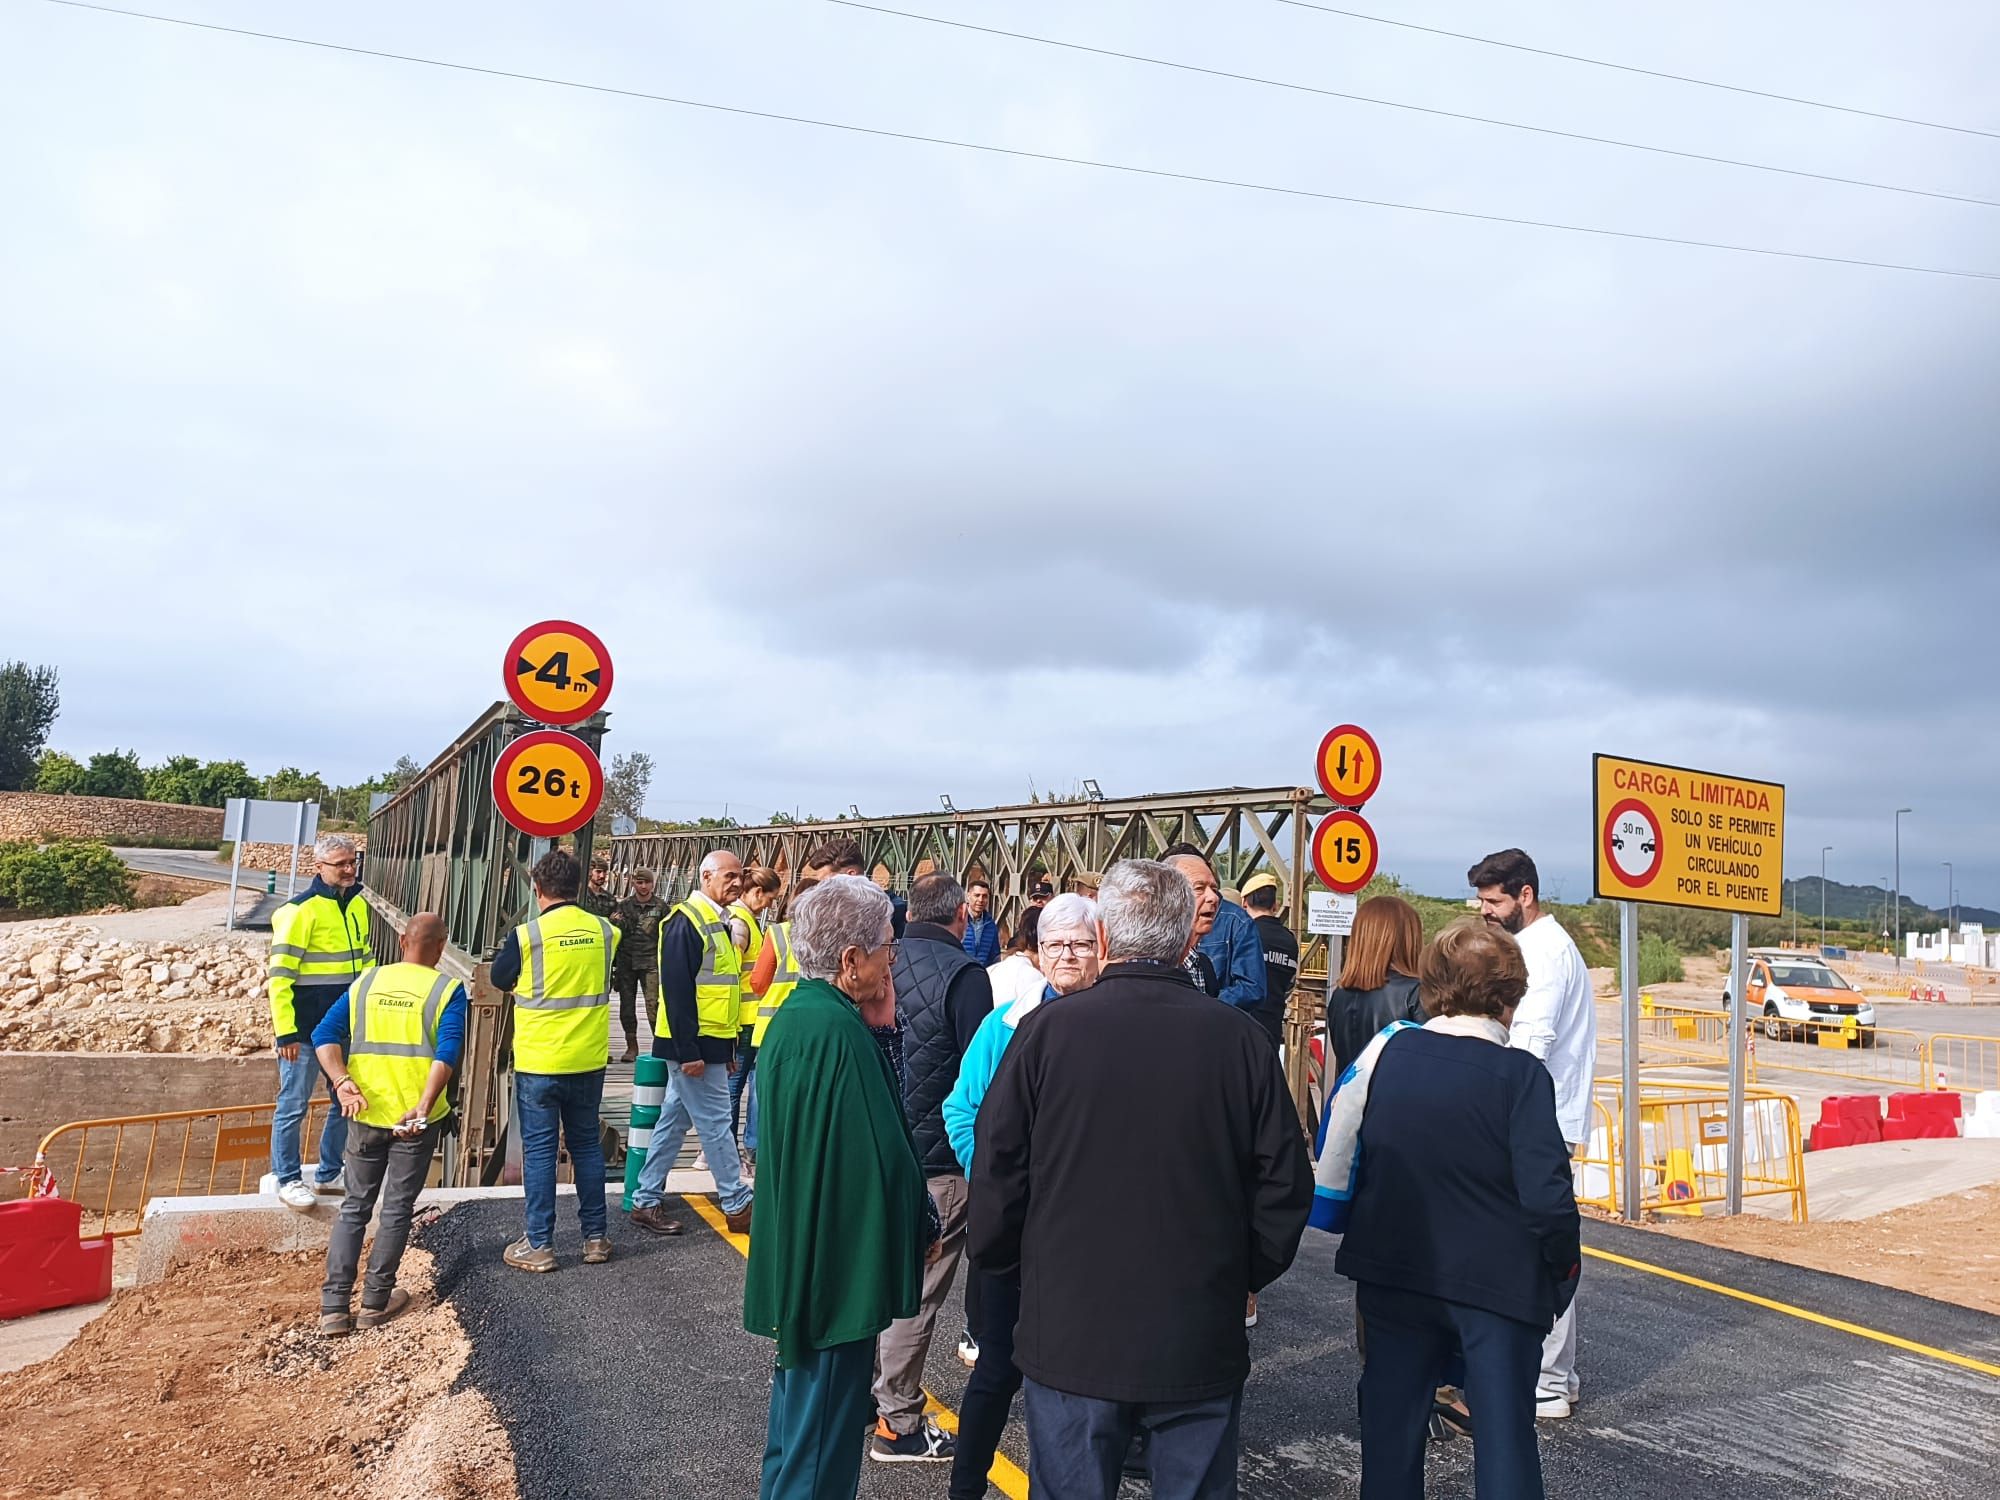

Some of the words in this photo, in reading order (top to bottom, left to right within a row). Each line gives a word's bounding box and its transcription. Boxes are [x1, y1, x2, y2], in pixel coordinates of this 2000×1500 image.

[535, 651, 571, 690] 4
[573, 682, 588, 693] m
[518, 765, 567, 797] 26
[570, 780, 581, 798] t
[1613, 767, 1680, 798] CARGA
[1690, 780, 1770, 812] LIMITADA
[1623, 822, 1634, 834] 30
[1635, 826, 1644, 835] m
[1671, 807, 1702, 827] SOLO
[1708, 815, 1723, 830] SE
[1729, 816, 1776, 837] PERMITE
[1334, 837, 1361, 864] 15
[1685, 833, 1700, 849] UN
[1707, 835, 1762, 857] VEHÍCULO
[1688, 856, 1759, 879] CIRCULANDO
[1677, 877, 1701, 895] POR
[1707, 881, 1721, 897] EL
[1726, 883, 1769, 902] PUENTE
[560, 937, 594, 947] ELSAMEX
[1268, 950, 1289, 966] UME
[378, 999, 415, 1008] ELSAMEX
